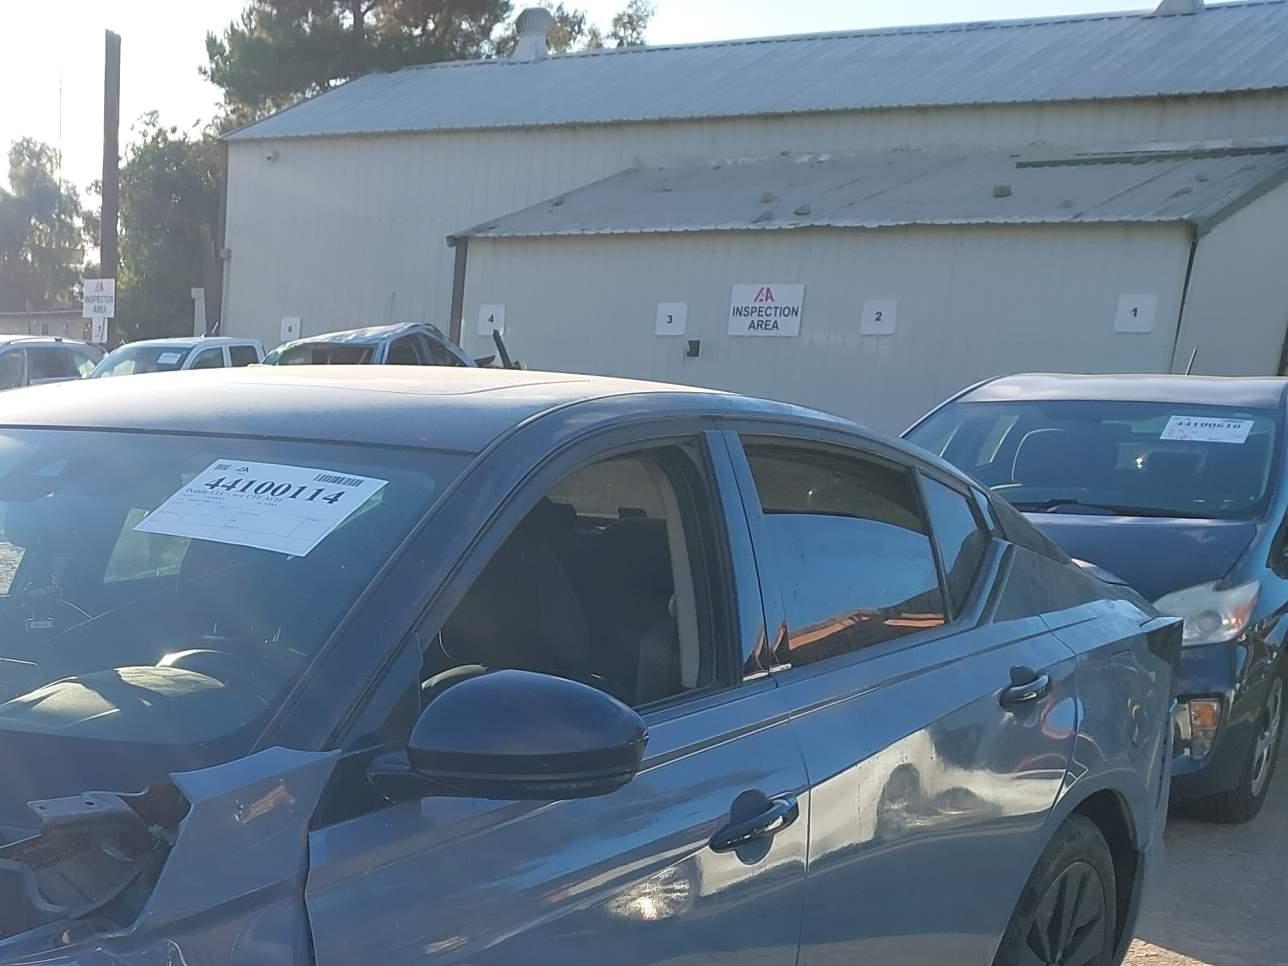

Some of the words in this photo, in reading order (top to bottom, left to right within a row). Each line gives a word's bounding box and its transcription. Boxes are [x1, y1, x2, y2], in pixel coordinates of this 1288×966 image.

[732, 306, 799, 318] INSPECTION
[874, 311, 883, 322] 2
[1131, 306, 1138, 318] 1
[487, 313, 494, 323] 4
[666, 314, 673, 324] 3
[747, 320, 779, 331] AREA
[204, 476, 345, 505] 44100114
